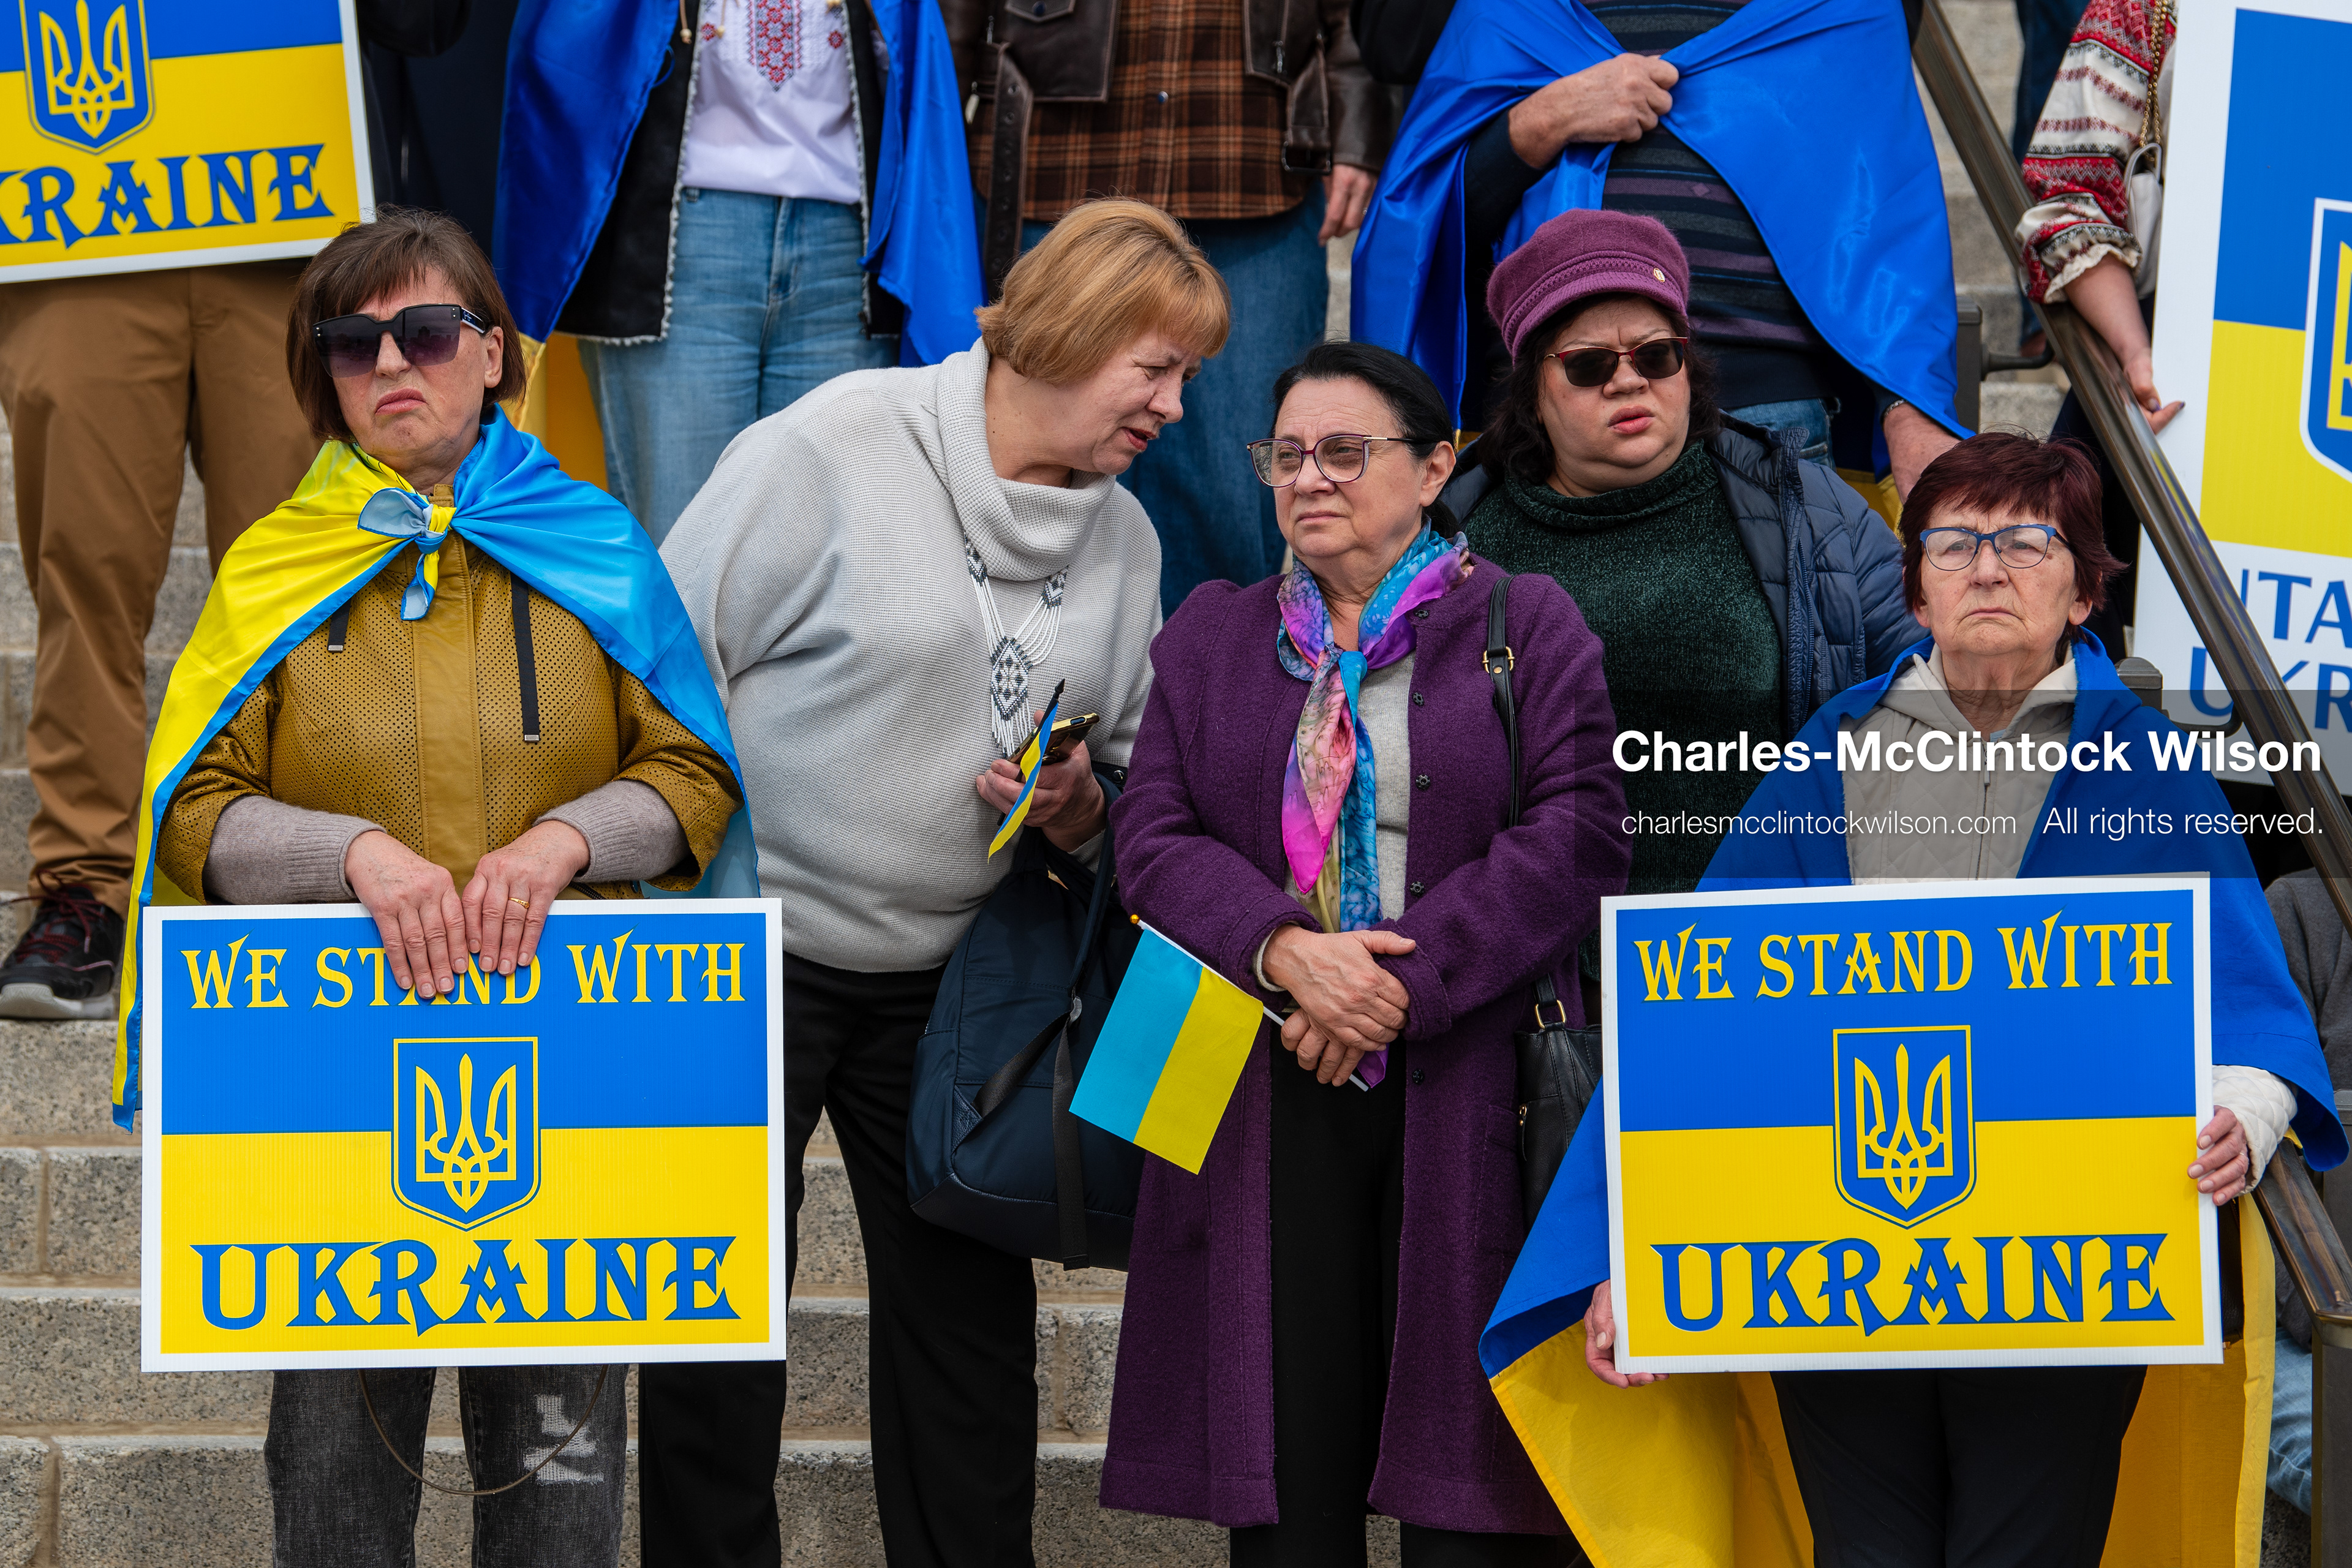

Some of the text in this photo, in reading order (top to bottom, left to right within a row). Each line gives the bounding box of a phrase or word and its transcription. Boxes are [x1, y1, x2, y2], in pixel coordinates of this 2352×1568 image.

[2240, 568, 2352, 649] TA
[2189, 646, 2352, 733] UR
[181, 931, 289, 1009] WE
[567, 929, 745, 1004] WITH
[1634, 909, 2173, 1001] WE STAND WITH
[190, 1235, 742, 1337] UKRAINE
[1650, 1232, 2175, 1337] UKRAINE
